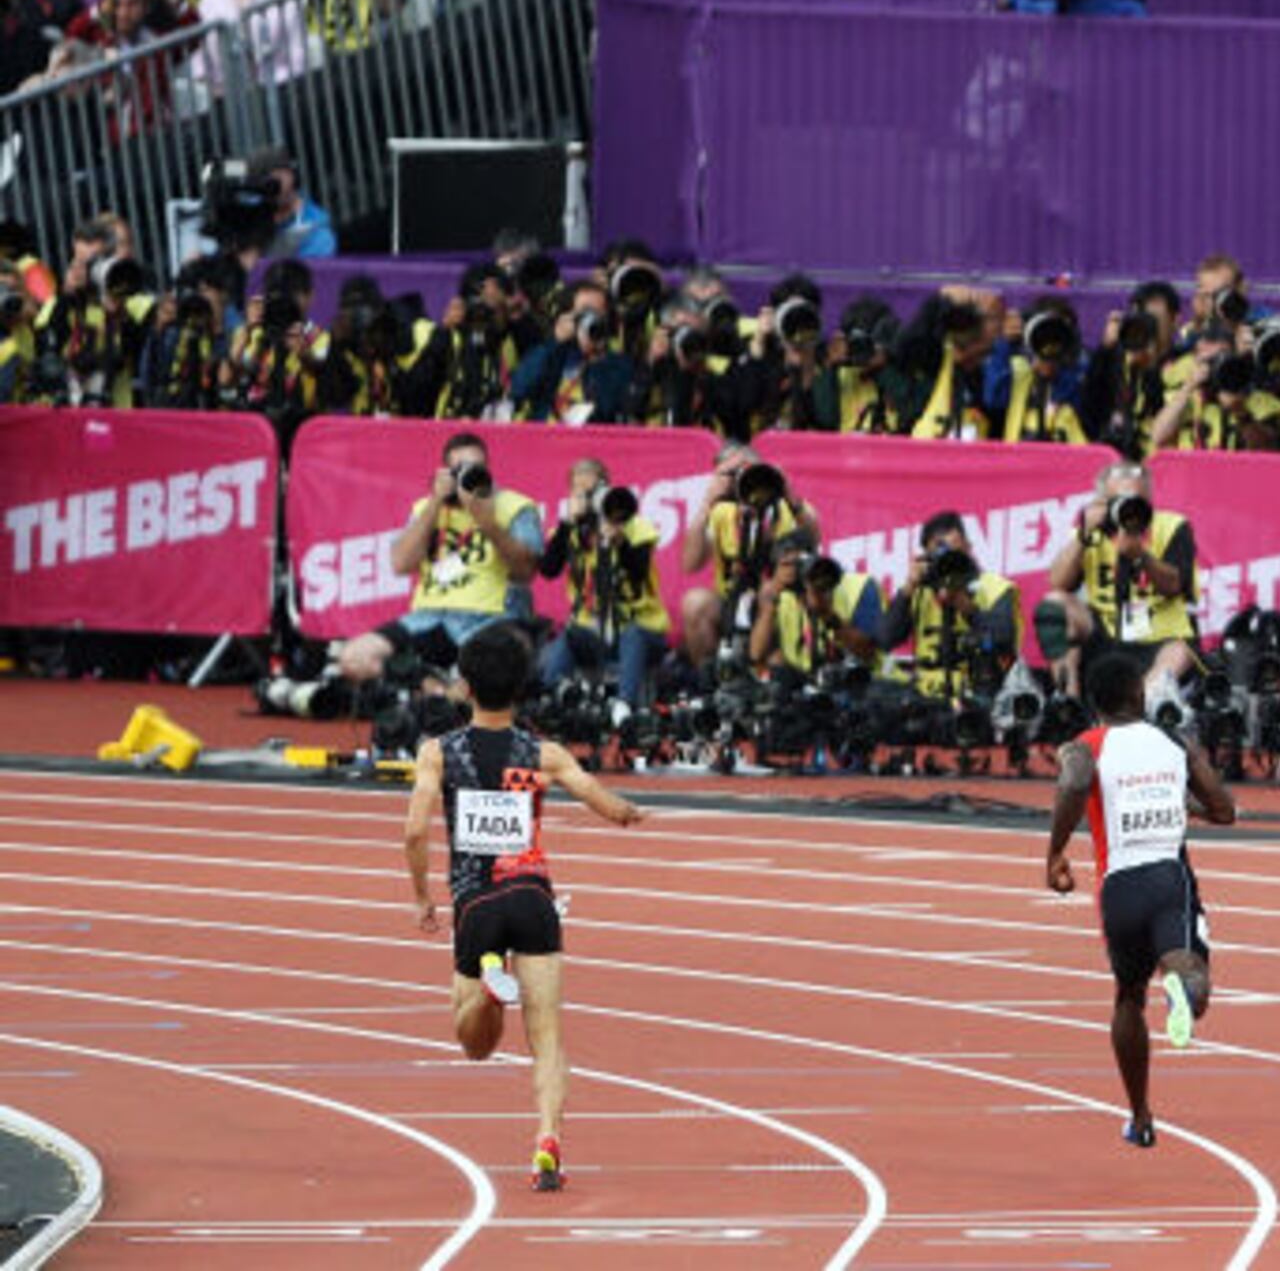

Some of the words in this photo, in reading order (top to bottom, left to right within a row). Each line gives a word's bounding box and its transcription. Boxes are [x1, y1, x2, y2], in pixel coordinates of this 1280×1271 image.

[5, 486, 117, 573] THE
[126, 458, 267, 553] BEST
[466, 813, 524, 837] TADA
